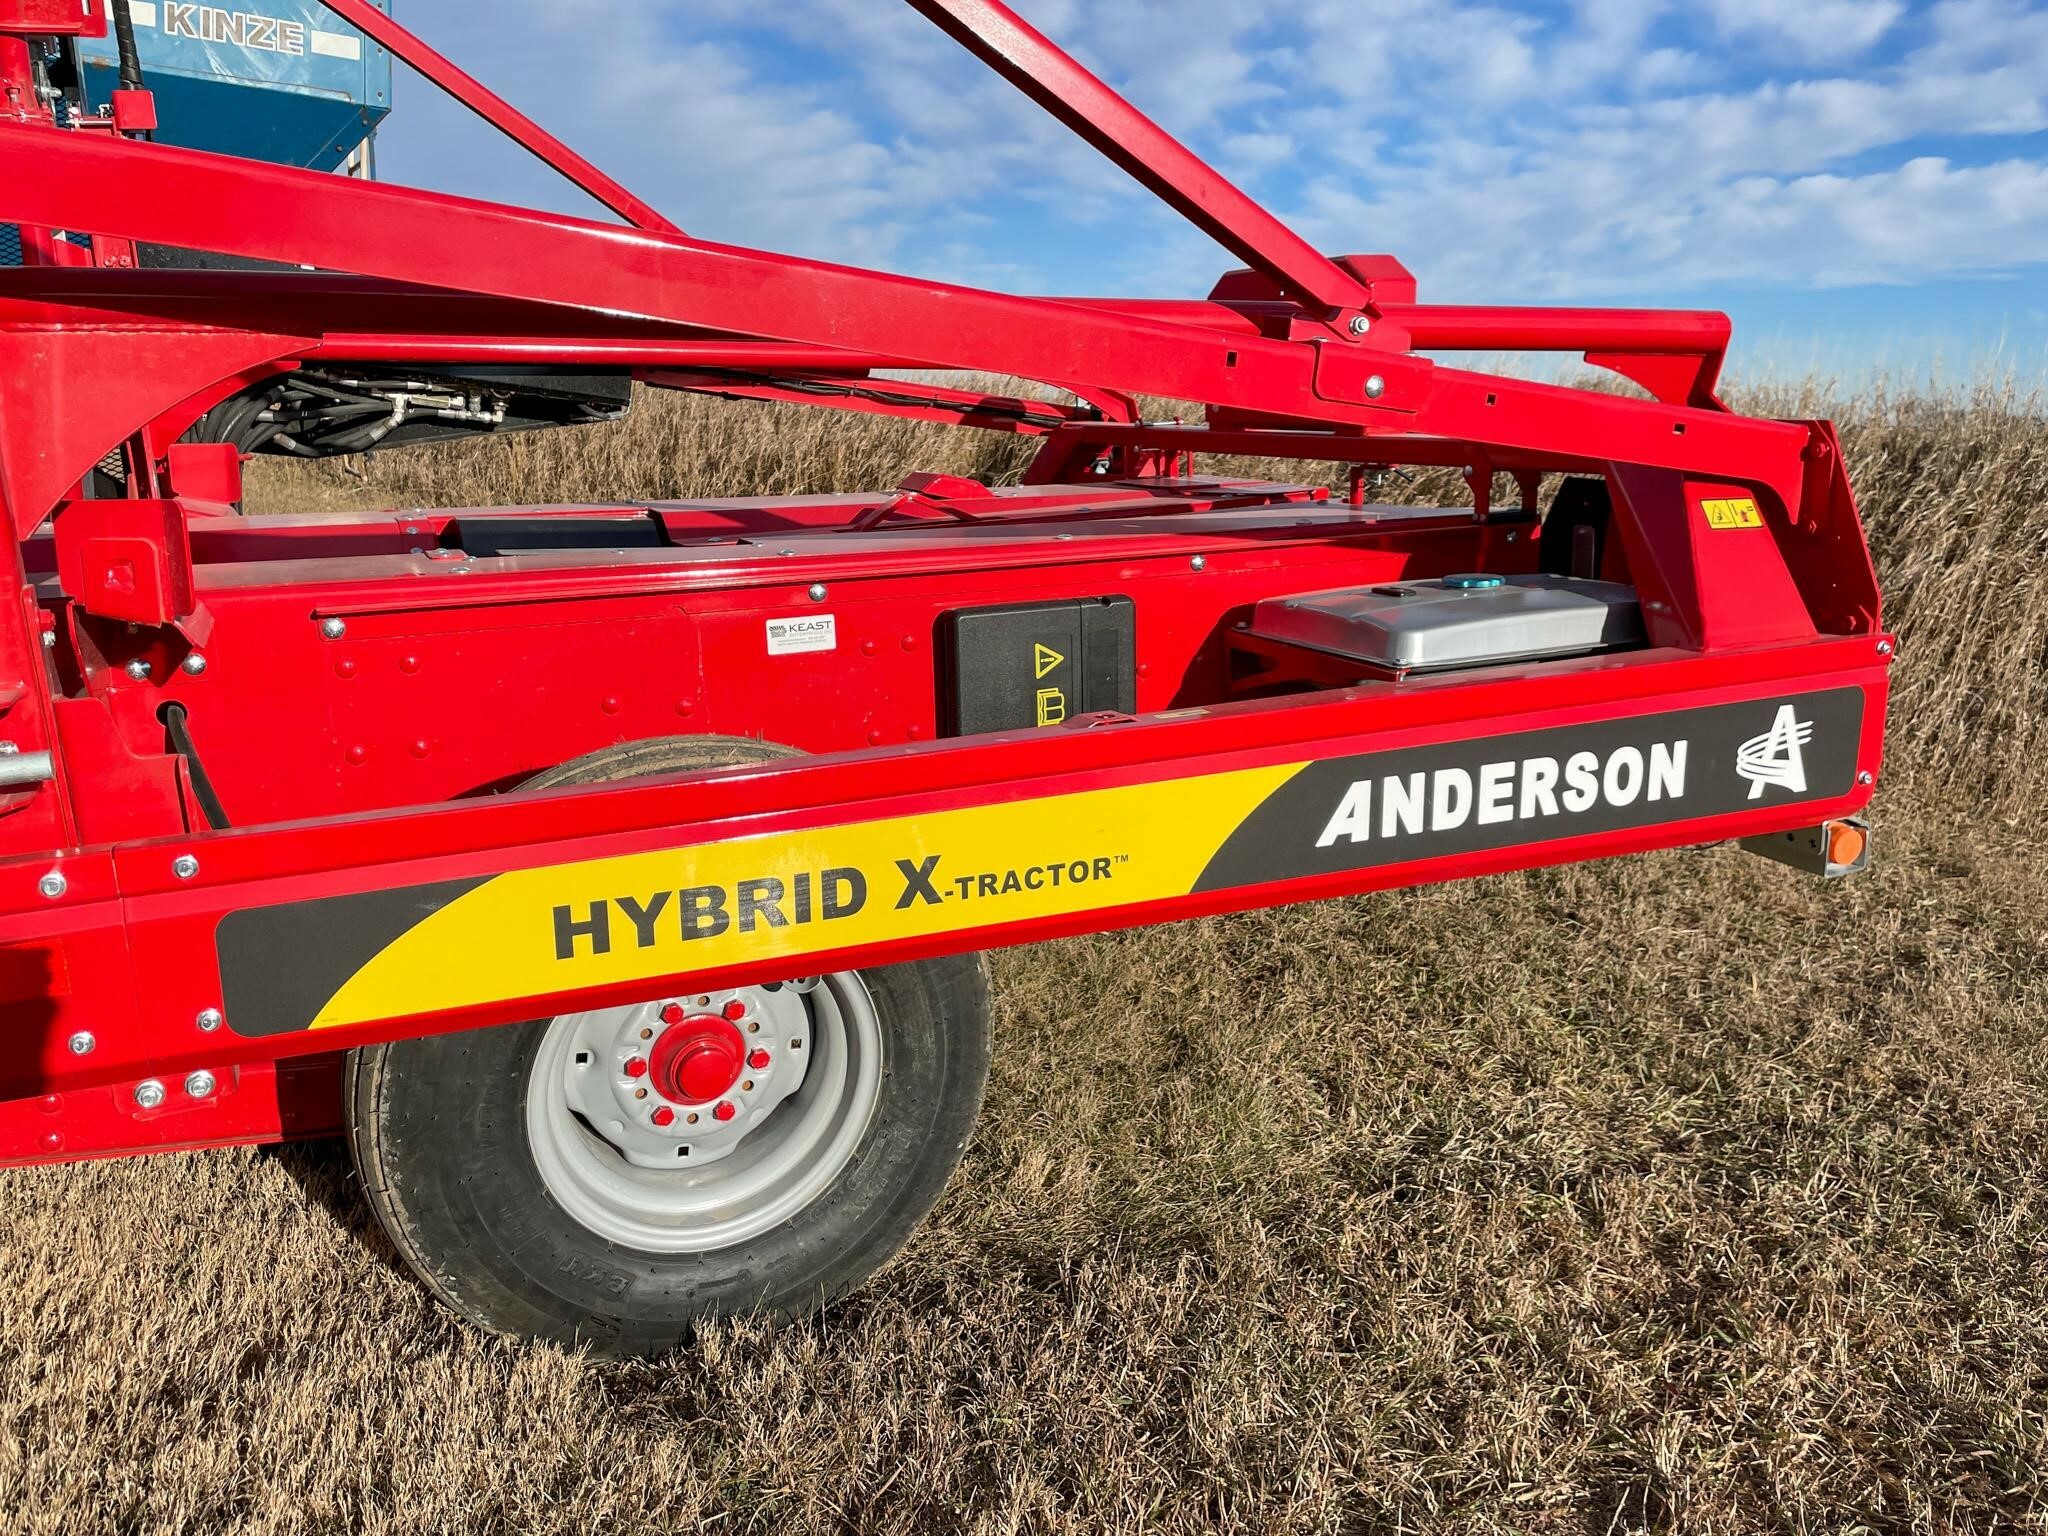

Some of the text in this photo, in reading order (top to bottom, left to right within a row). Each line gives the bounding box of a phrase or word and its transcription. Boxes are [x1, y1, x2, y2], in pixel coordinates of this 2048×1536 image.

[164, 1, 304, 55] KINZE
[789, 620, 832, 632] KEAST
[1315, 740, 1688, 847] ANDERSON
[552, 867, 867, 960] HYBRID
